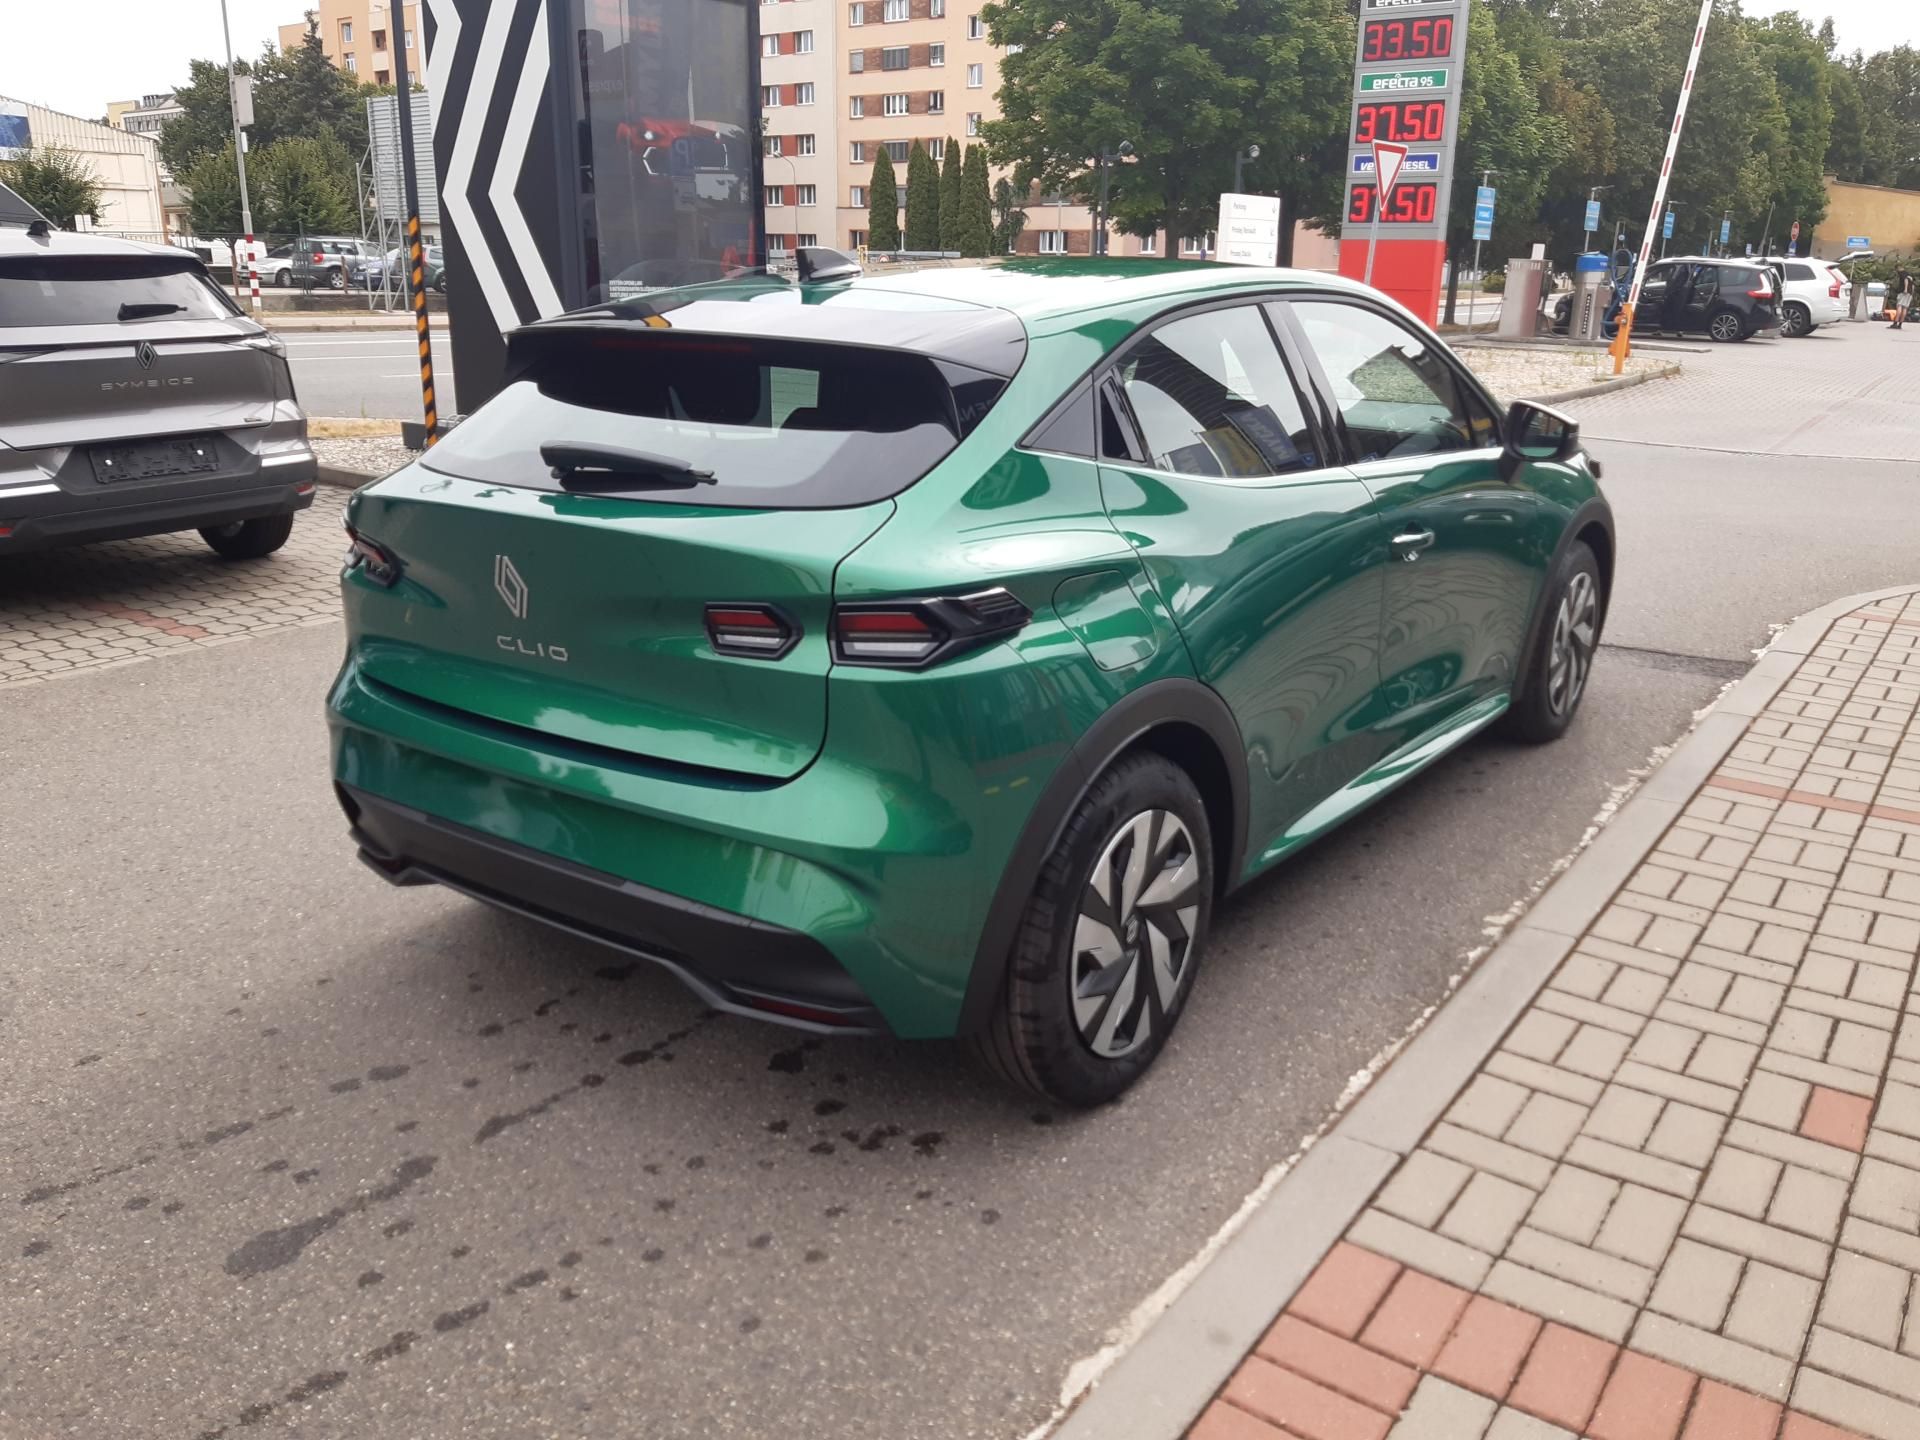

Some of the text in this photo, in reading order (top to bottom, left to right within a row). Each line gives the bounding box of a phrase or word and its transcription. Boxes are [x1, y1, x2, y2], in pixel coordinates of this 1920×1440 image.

[1364, 18, 1452, 60] 33.50
[1420, 76, 1433, 87] 95
[1357, 103, 1443, 142] 37.50
[1401, 160, 1430, 170] IESEL
[496, 635, 569, 662] CLIO
